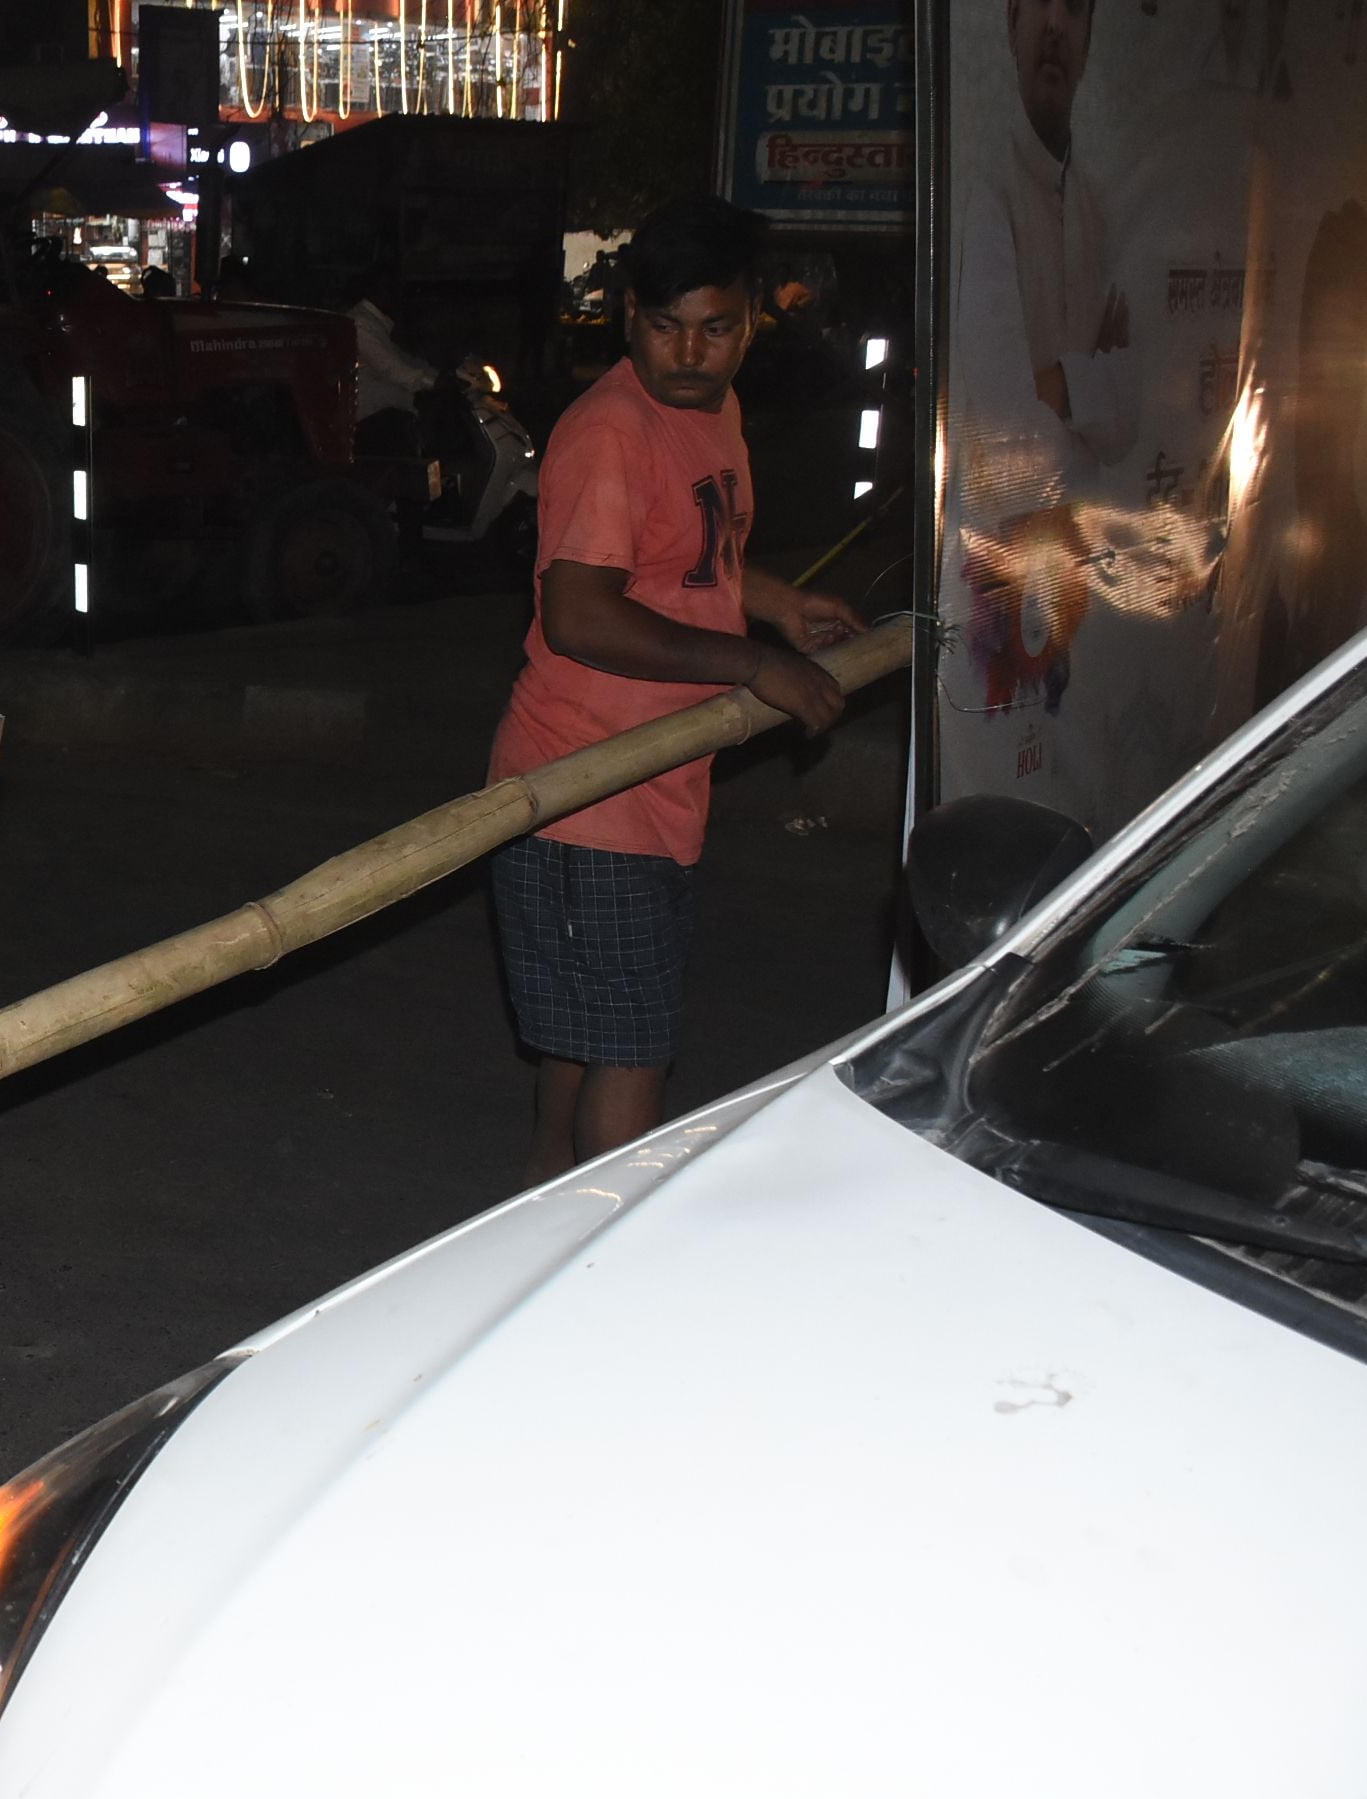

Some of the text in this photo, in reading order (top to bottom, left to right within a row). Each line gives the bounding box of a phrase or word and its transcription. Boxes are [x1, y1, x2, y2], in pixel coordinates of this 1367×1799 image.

[765, 70, 886, 124] प्रयोग
[189, 337, 257, 353] Mahindra
[1016, 742, 1042, 778] HOLI
